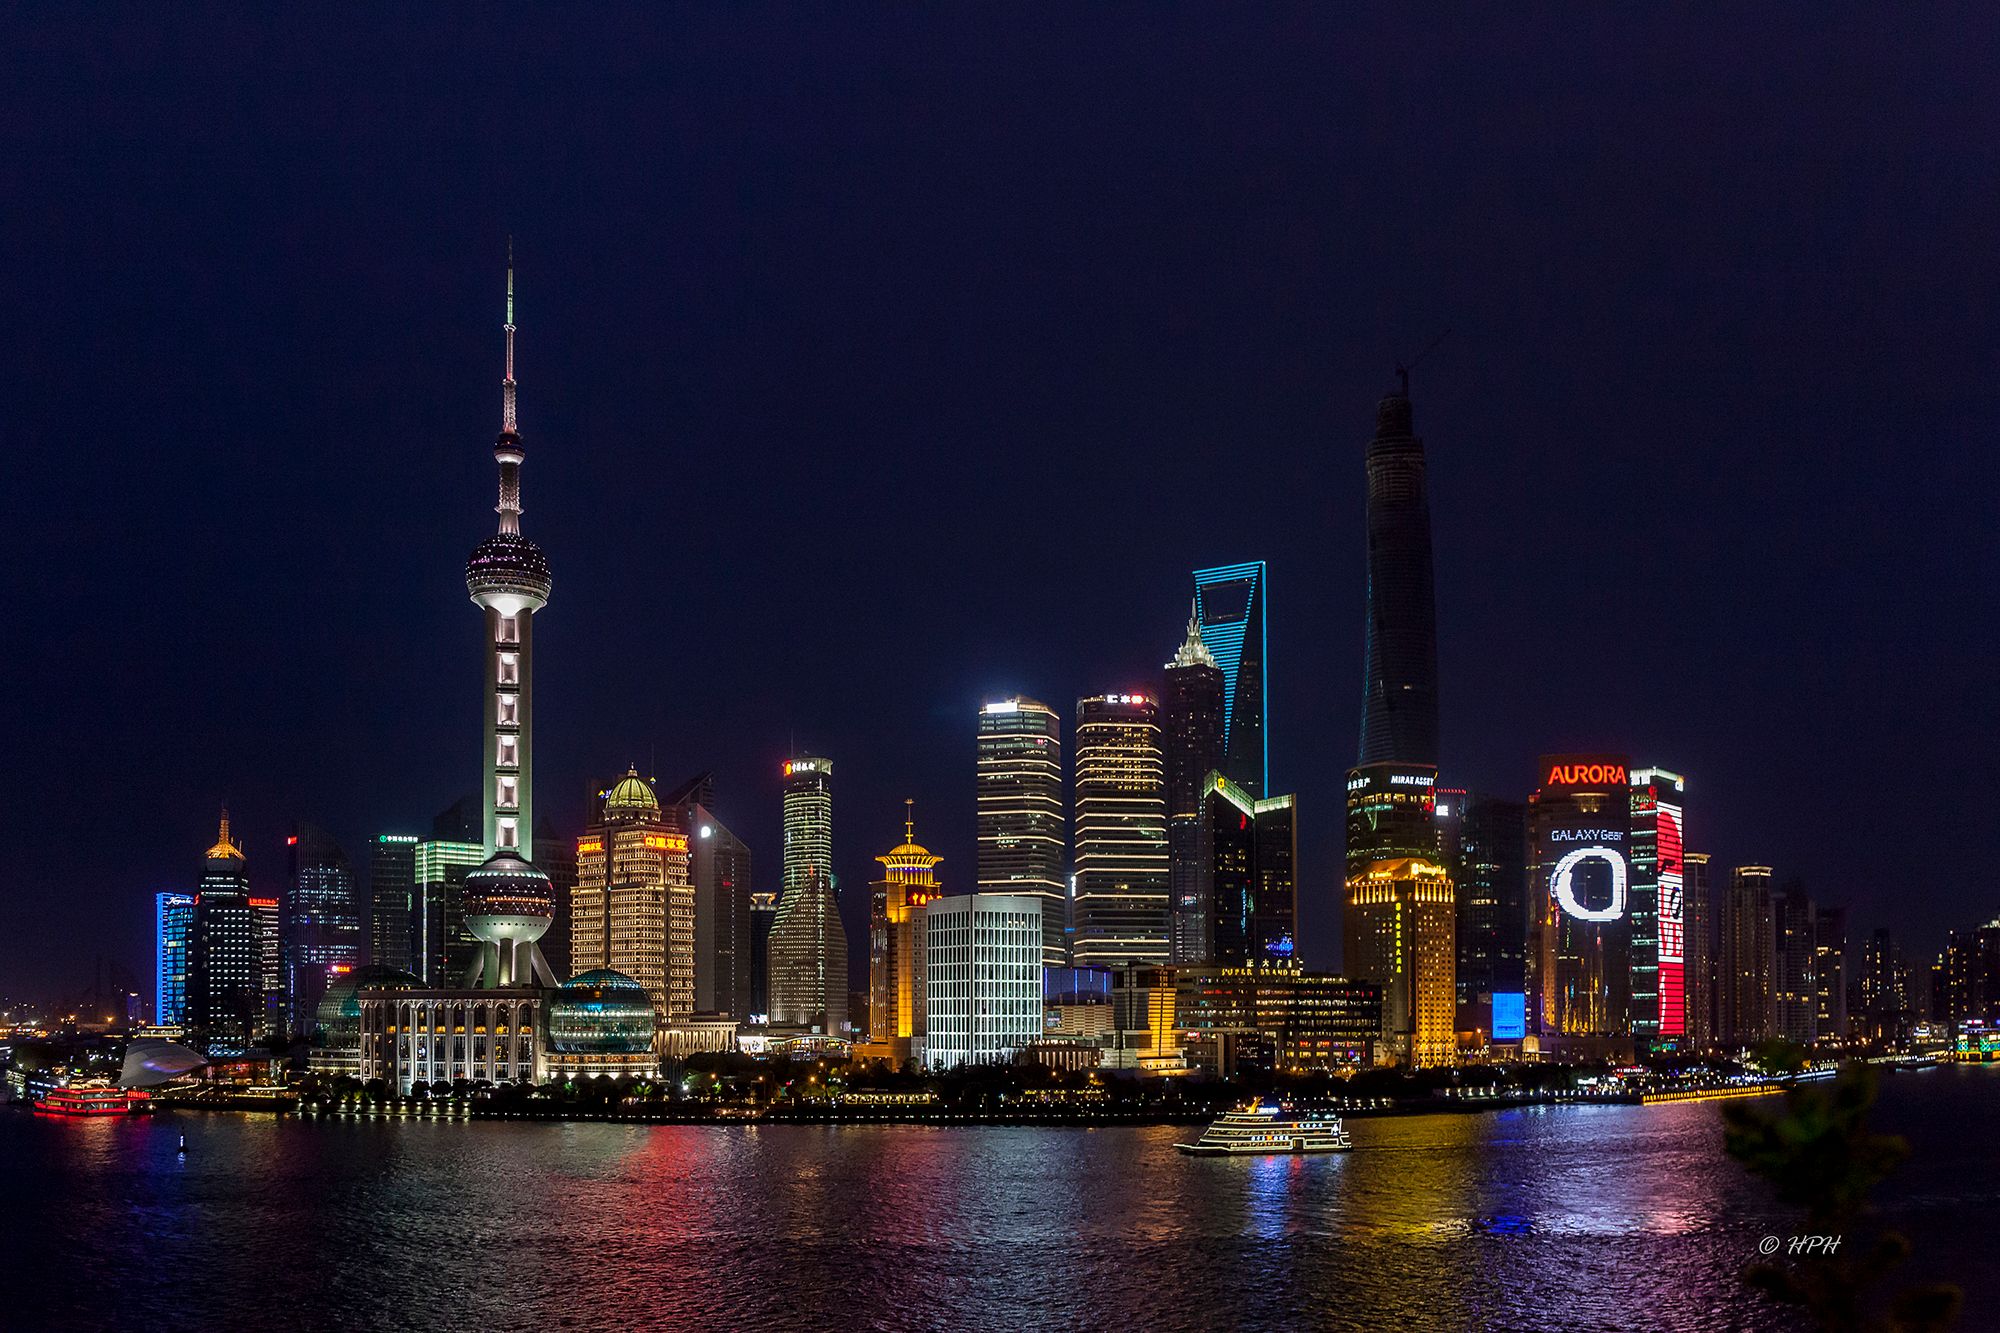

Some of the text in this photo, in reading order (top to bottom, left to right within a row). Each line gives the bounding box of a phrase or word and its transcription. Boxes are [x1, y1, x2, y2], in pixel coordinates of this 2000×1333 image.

[1391, 775, 1434, 786] MIRAE ASSET
[1548, 765, 1627, 785] AURORA
[1551, 829, 1624, 841] GALAXY Gear
